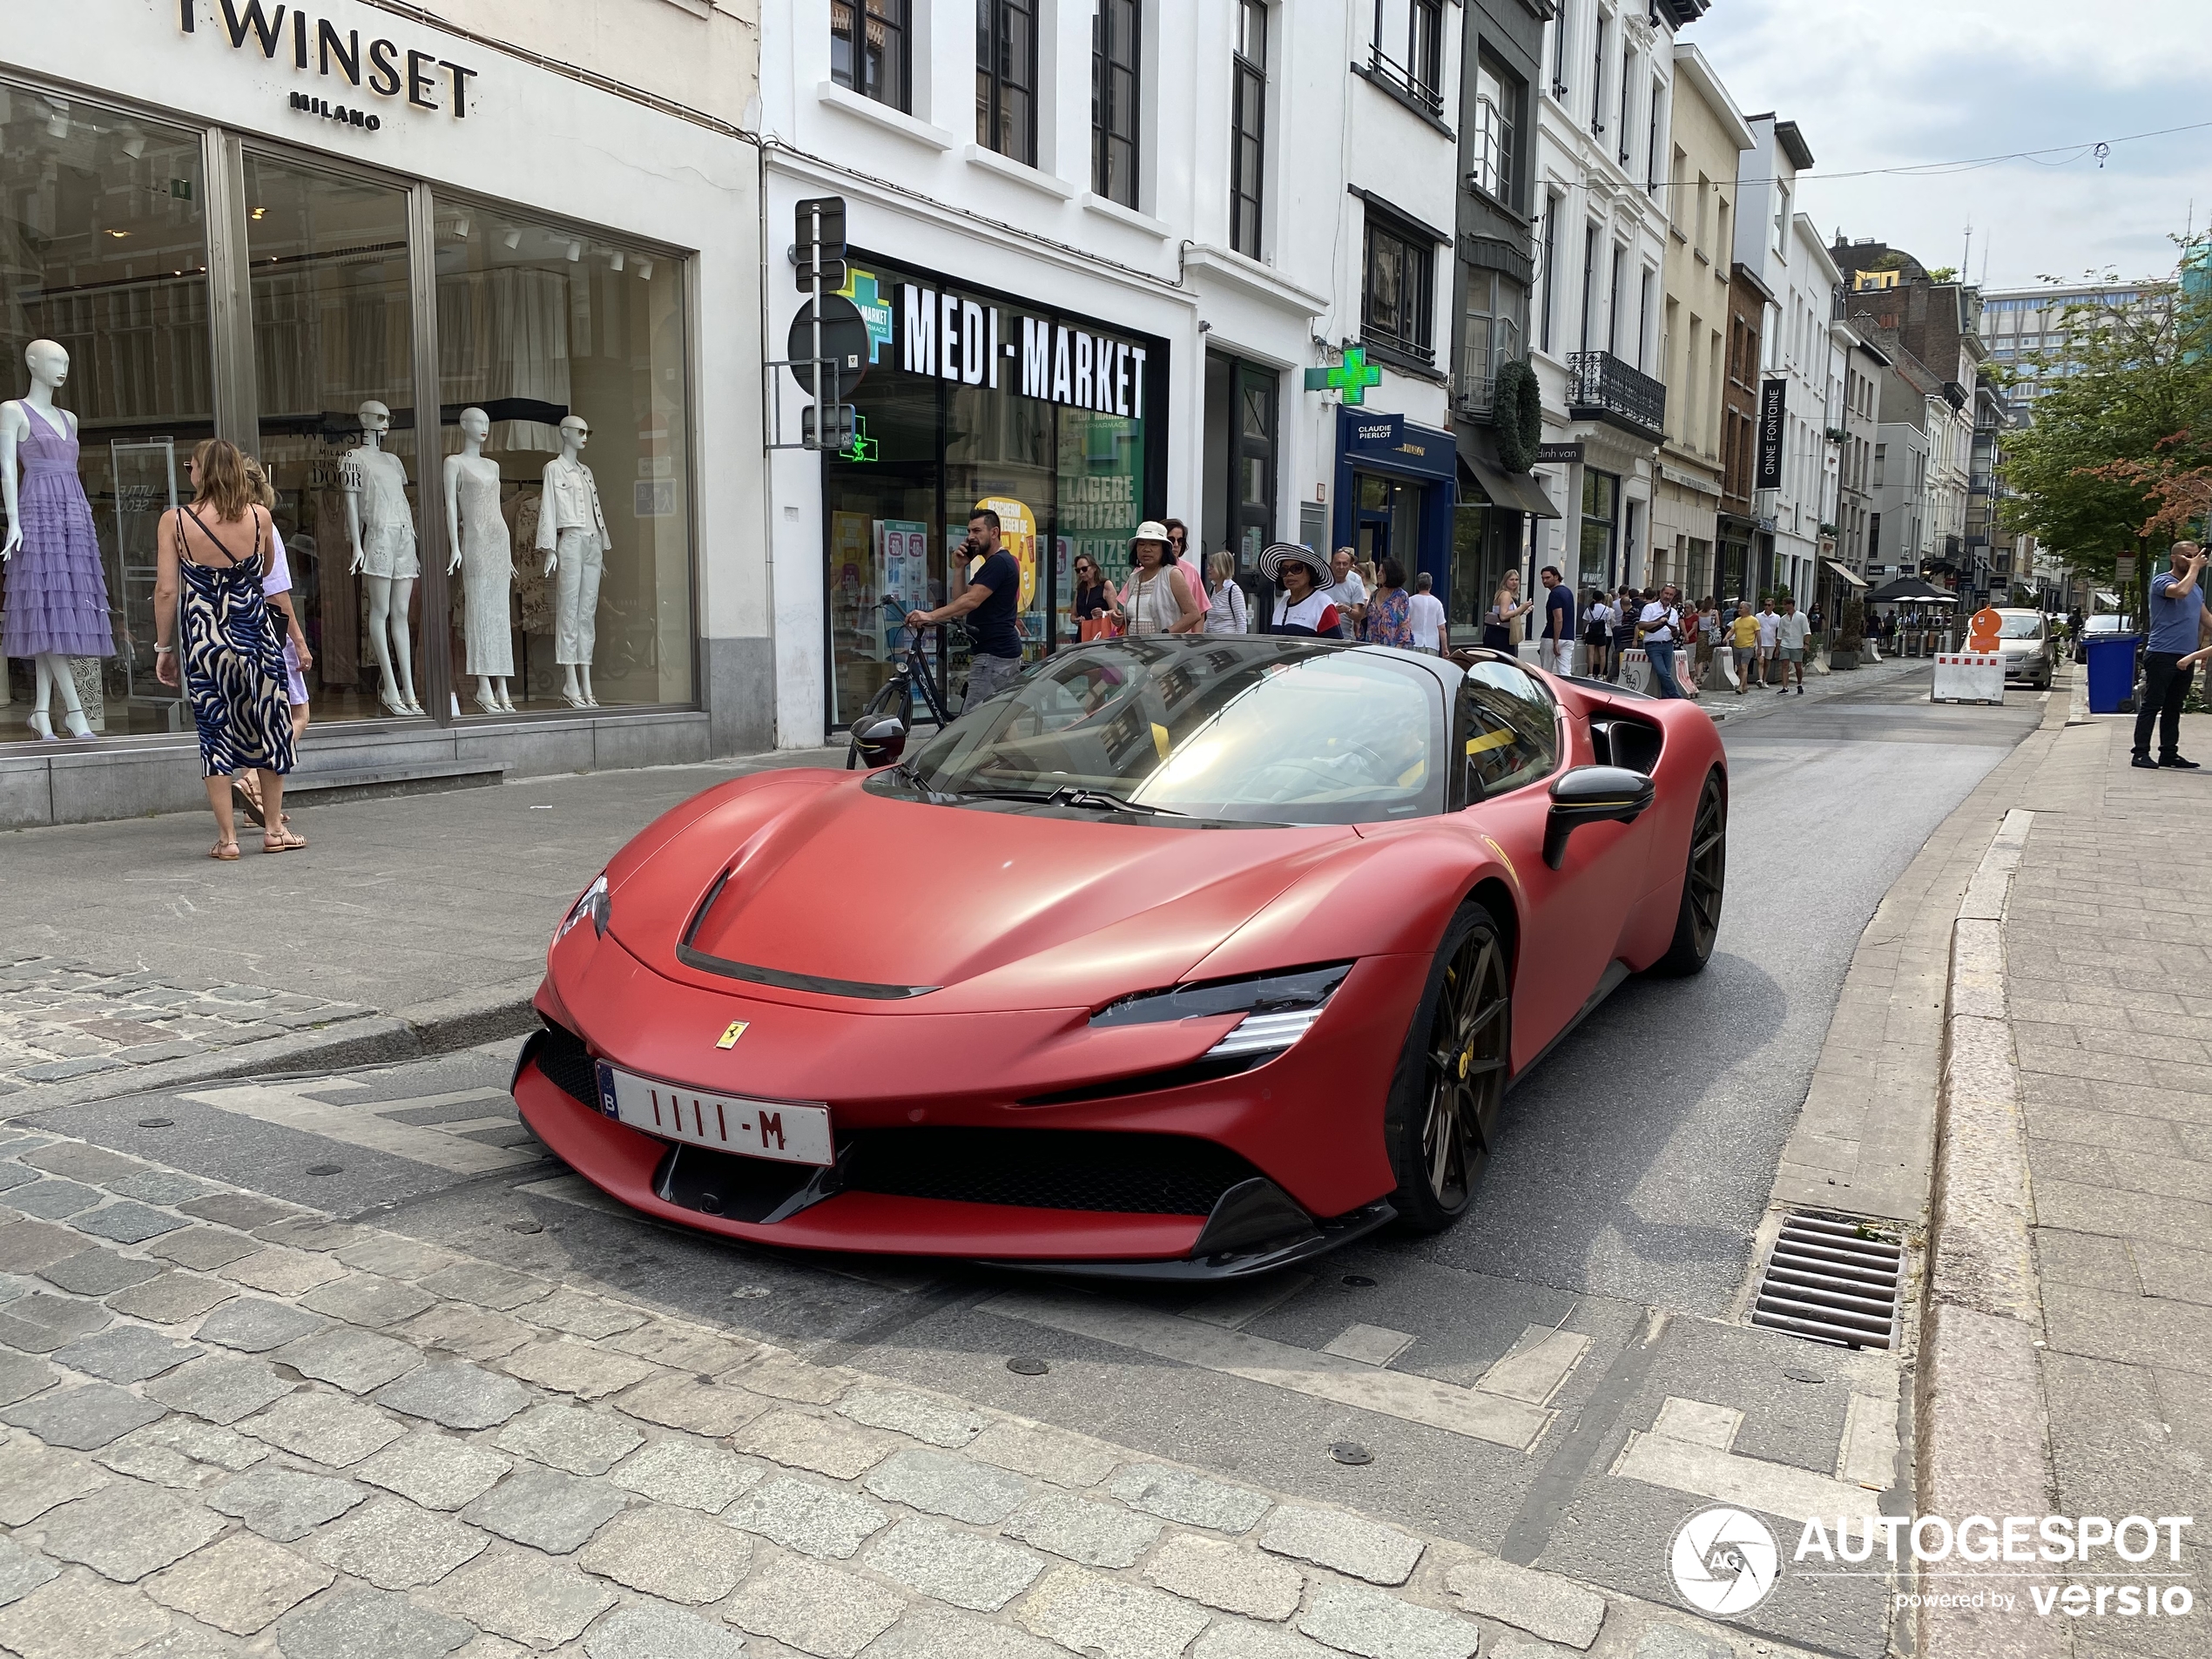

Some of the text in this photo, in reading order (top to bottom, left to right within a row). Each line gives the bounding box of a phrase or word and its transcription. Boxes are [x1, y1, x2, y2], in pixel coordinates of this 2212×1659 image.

[289, 91, 381, 131] MILANO
[1359, 424, 1392, 433] CLAUDIE
[319, 448, 352, 457] MILANO
[344, 462, 361, 471] THE
[314, 469, 361, 487] DOOR
[1066, 475, 1134, 502] LAGERE
[1063, 502, 1137, 529] PRIJZEN
[1020, 519, 1028, 534] DE
[1073, 539, 1127, 566] KEUZE
[604, 1093, 615, 1112] B
